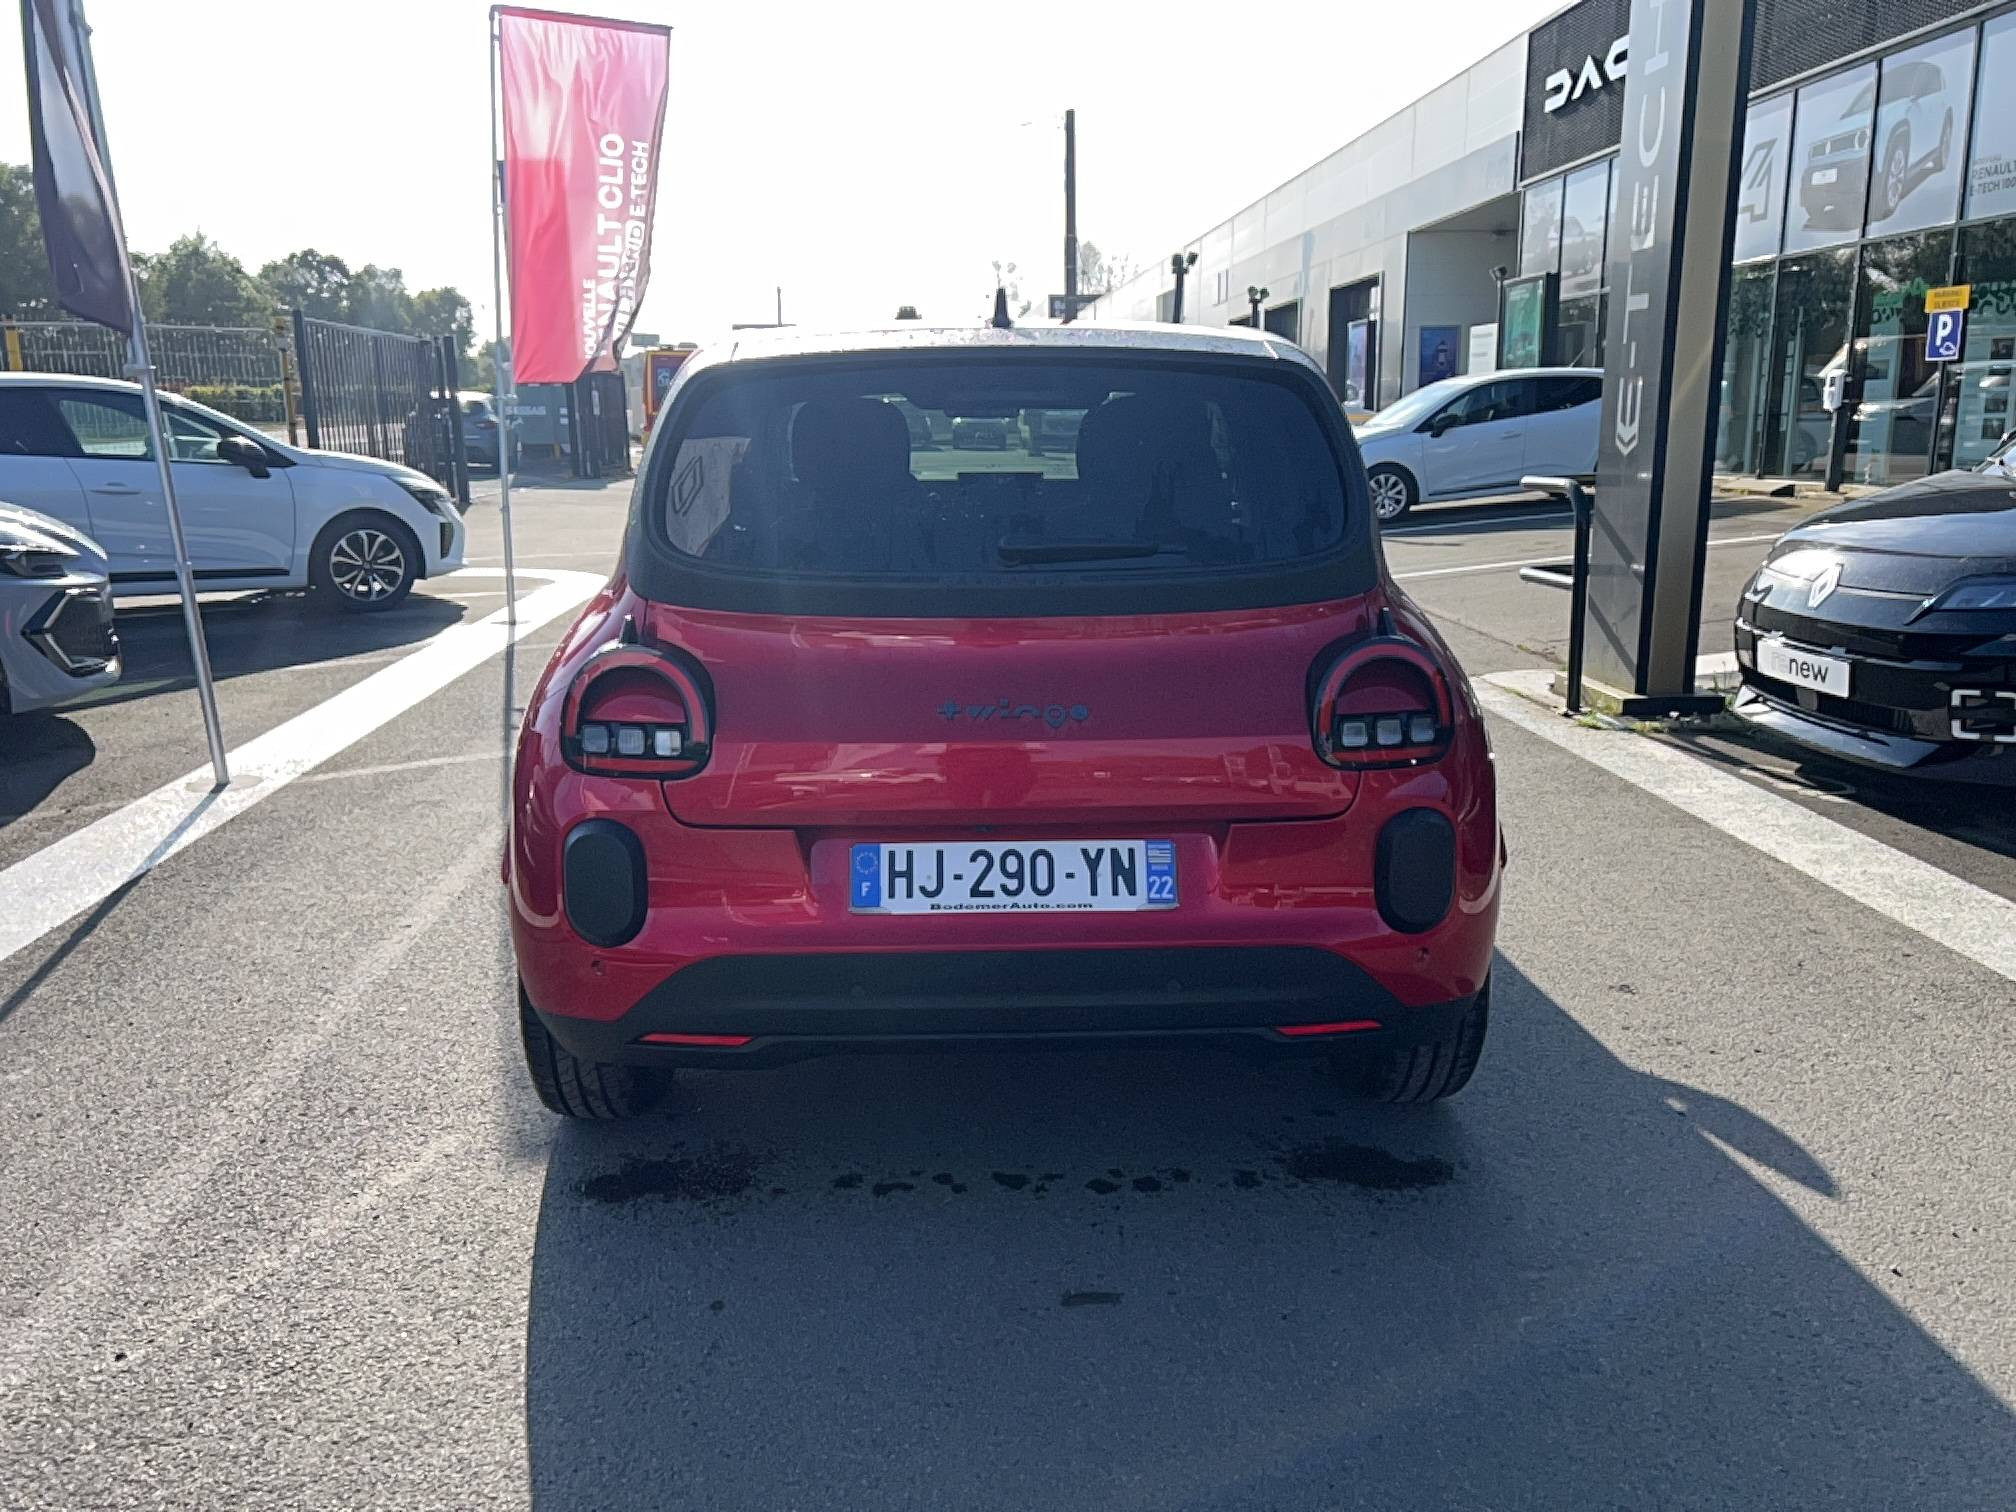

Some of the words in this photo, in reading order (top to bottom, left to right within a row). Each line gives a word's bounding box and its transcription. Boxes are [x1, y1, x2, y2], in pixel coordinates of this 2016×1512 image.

[598, 133, 625, 209] CLIO
[583, 278, 595, 359] OUVELLE
[1935, 313, 1953, 347] P
[861, 882, 872, 897] F
[888, 847, 1137, 899] HJ-290-YN
[1149, 875, 1174, 899] 22
[930, 902, 1093, 911] BodemerAuto.com
